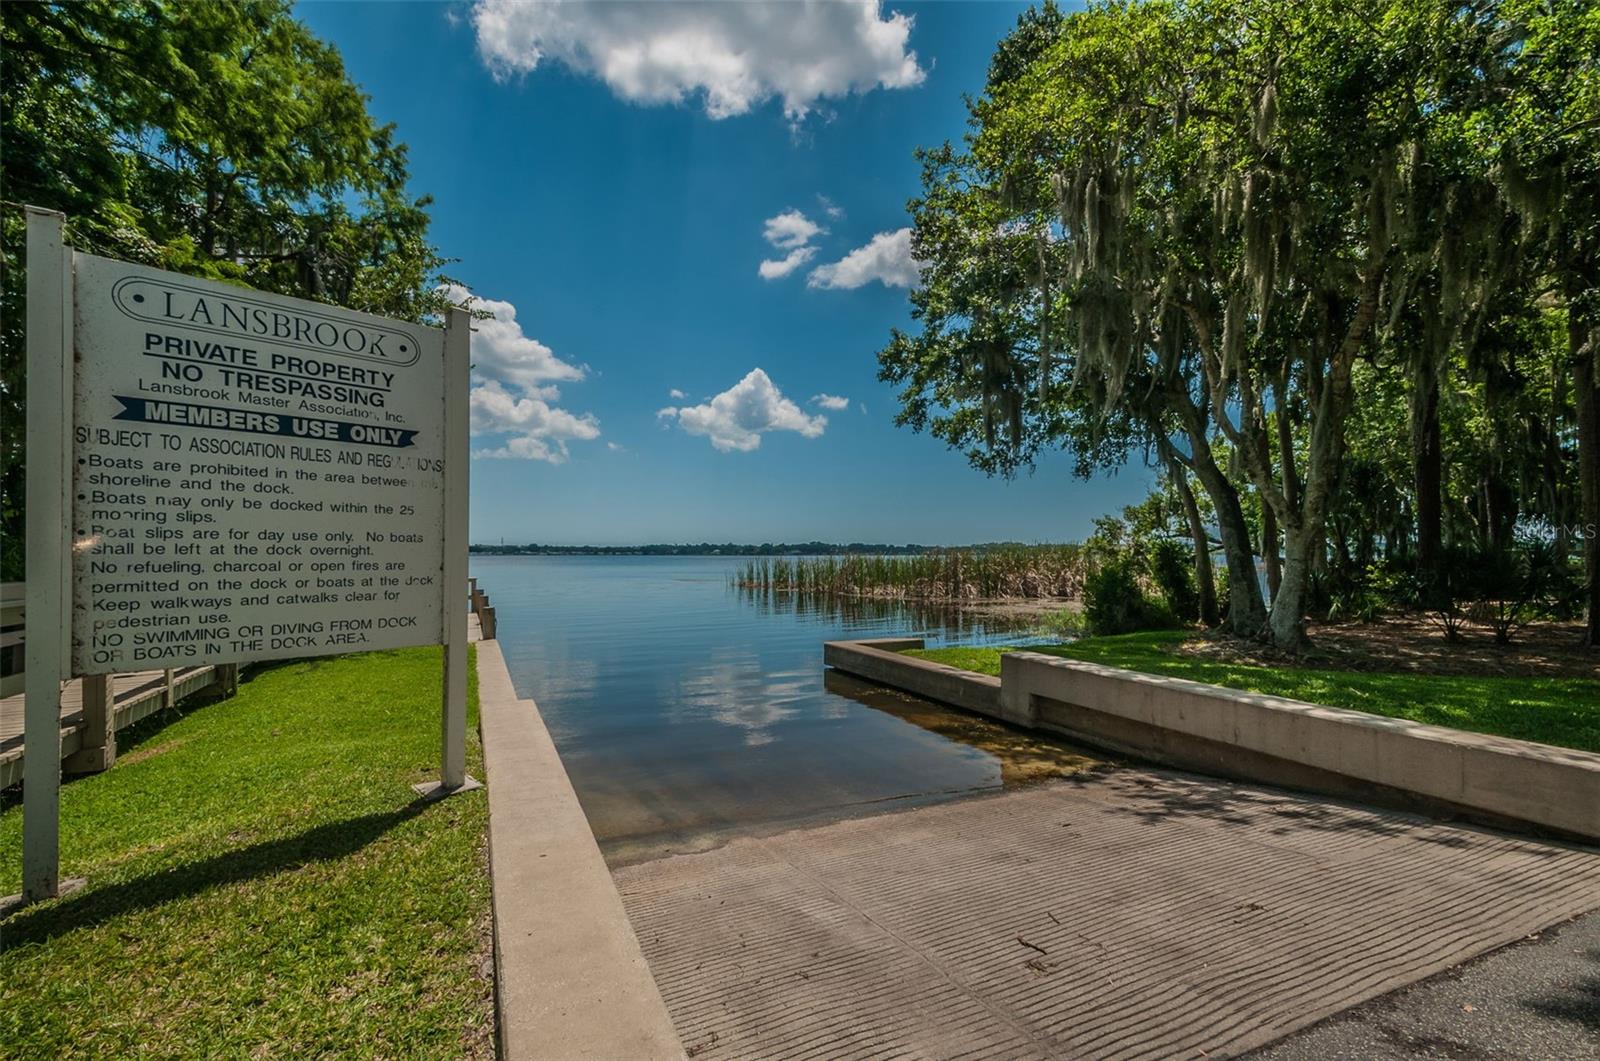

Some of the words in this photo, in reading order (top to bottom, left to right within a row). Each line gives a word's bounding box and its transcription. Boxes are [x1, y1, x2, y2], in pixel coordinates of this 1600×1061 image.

[162, 292, 388, 357] LANSBROOK
[145, 333, 257, 366] PRIVATE
[271, 353, 394, 387] PROPERTY
[161, 361, 203, 382] NO
[219, 369, 385, 407] TRESPASSING
[139, 378, 230, 401] Lansbrook
[238, 391, 290, 408] Master
[385, 411, 405, 423] Inc.
[145, 401, 280, 433] MEMBERS
[292, 418, 339, 439] USE
[350, 425, 403, 446] ONLY
[75, 426, 152, 448] SUBJECT
[160, 434, 182, 451] TO
[189, 437, 285, 460] ASSOCIATION
[291, 446, 332, 463] RULES
[337, 451, 362, 465] AND
[89, 454, 143, 470] Boats
[153, 461, 181, 472] are
[190, 463, 268, 478] prohibited
[276, 467, 287, 479] in
[295, 469, 317, 481] the
[324, 474, 355, 484] area
[89, 473, 171, 488] shoreline
[180, 479, 212, 490] and
[221, 480, 245, 492] the
[253, 482, 294, 495] dock.
[92, 490, 146, 505] Boats
[201, 497, 234, 511] only
[243, 498, 262, 509] be
[270, 499, 323, 512] docked
[330, 502, 367, 514] within
[374, 504, 393, 515] the
[400, 505, 415, 515] 25
[176, 511, 216, 525] slips.
[145, 527, 184, 542] slips
[193, 530, 220, 540] are
[229, 528, 249, 540] for
[258, 529, 285, 543] day
[292, 531, 318, 541] use
[325, 532, 354, 544] only.
[366, 532, 384, 543] No
[390, 532, 424, 543] boats
[91, 543, 134, 555] shall
[143, 543, 166, 555] be
[175, 543, 200, 555] left
[210, 544, 225, 555] at
[234, 544, 258, 555] the
[266, 544, 302, 556] dock
[310, 545, 374, 558] overnight.
[91, 561, 117, 574] No
[213, 561, 281, 573] charcoal
[288, 562, 303, 572] or
[311, 562, 345, 573] open
[352, 561, 379, 571] fires
[385, 561, 405, 571] are
[91, 580, 179, 595] permitted
[188, 582, 208, 592] on
[218, 579, 242, 590] the
[250, 578, 287, 590] dock
[295, 579, 310, 589] or
[316, 577, 355, 588] boats
[361, 577, 373, 587] at
[380, 575, 399, 586] the
[92, 598, 140, 613] Keep
[151, 597, 232, 610] walkways
[240, 594, 269, 606] and
[277, 591, 338, 605] catwalks
[345, 591, 377, 602] clear
[384, 589, 400, 601] for
[93, 614, 190, 634] pedestrian
[198, 613, 232, 624] use.
[93, 632, 123, 648] NO
[133, 627, 230, 646] SWIMMING
[238, 625, 263, 638] OR
[271, 621, 324, 636] DIVING
[330, 619, 372, 631] FROM
[378, 616, 417, 629] DOCK
[134, 644, 197, 661] BOATS
[205, 643, 221, 655] IN
[230, 639, 263, 653] THE
[271, 636, 317, 650] DOCK
[325, 632, 370, 647] AREA.
